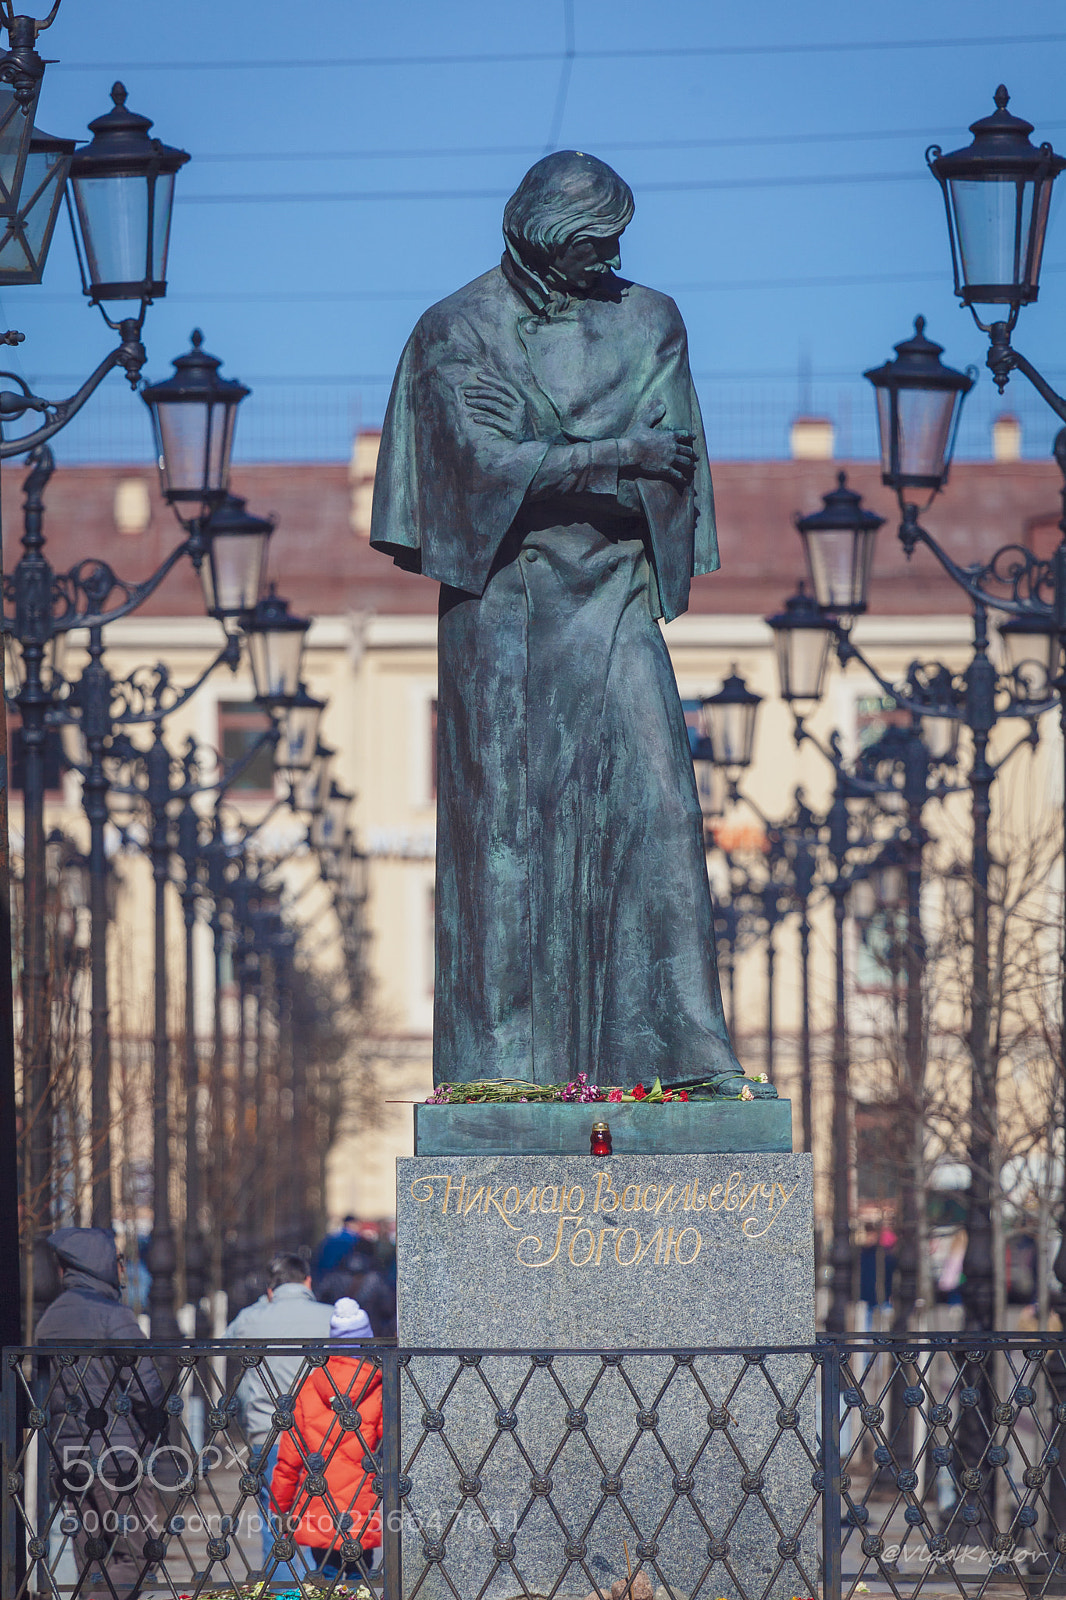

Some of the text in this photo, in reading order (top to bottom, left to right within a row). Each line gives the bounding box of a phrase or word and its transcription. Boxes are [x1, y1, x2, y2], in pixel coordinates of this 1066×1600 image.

[411, 1172, 799, 1238] Николаю Васильевичу
[517, 1216, 702, 1268] Гоголю
